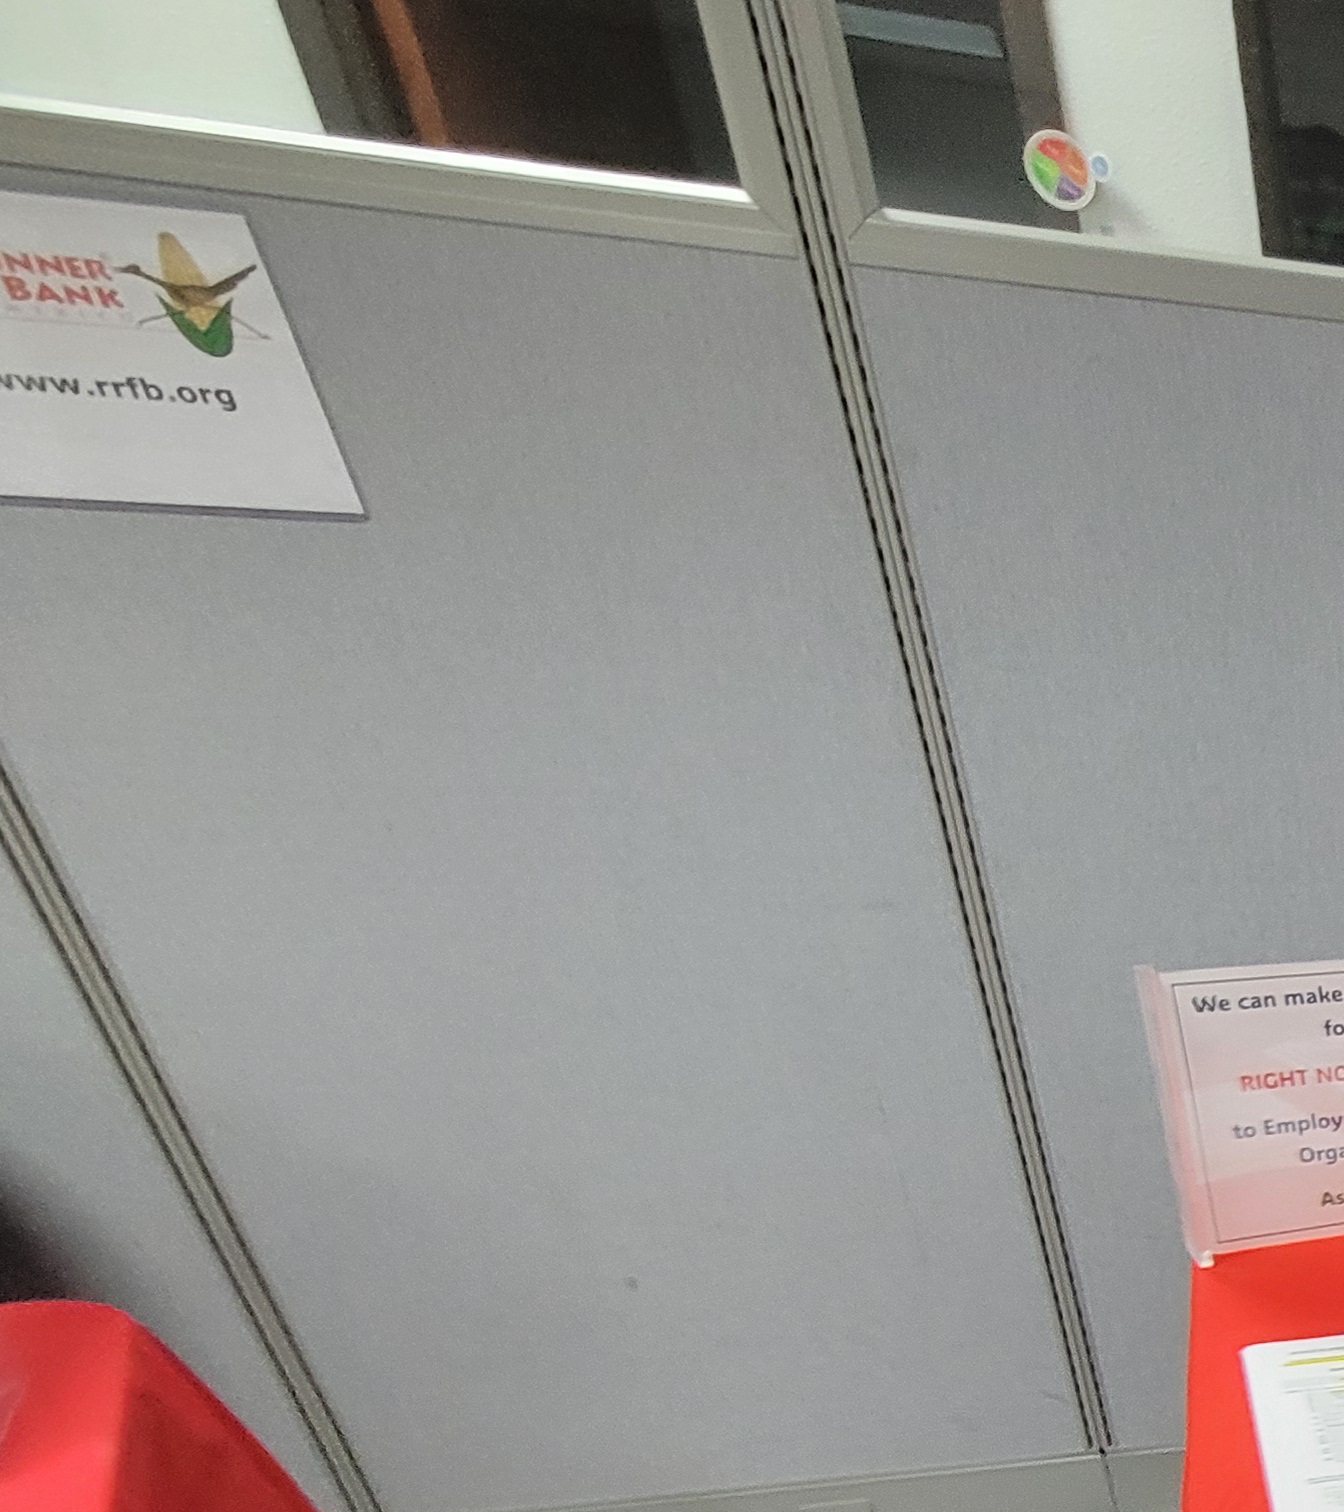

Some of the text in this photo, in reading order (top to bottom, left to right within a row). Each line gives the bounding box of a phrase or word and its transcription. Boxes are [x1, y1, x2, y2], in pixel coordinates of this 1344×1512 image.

[0, 252, 112, 281] NNER
[1, 275, 125, 308] BANK
[1192, 994, 1232, 1013] We
[1238, 992, 1277, 1010] can
[1284, 984, 1344, 1006] make
[1239, 1068, 1309, 1092] RIGHT
[1232, 1123, 1257, 1140] to
